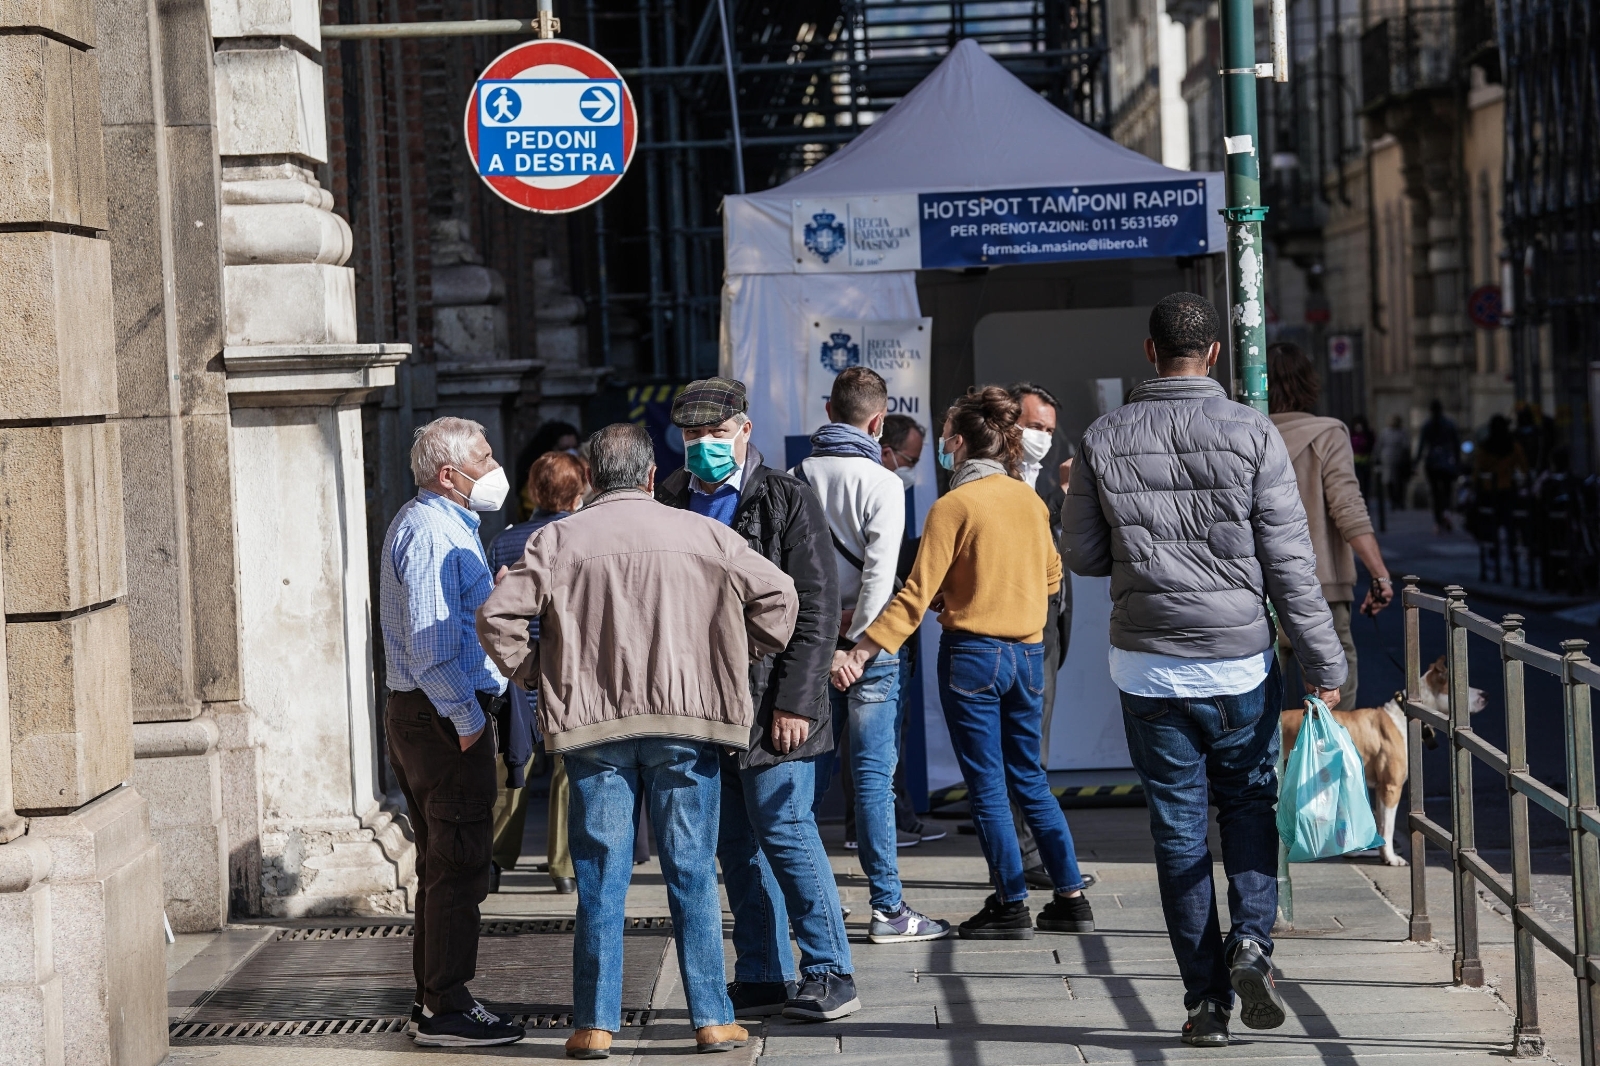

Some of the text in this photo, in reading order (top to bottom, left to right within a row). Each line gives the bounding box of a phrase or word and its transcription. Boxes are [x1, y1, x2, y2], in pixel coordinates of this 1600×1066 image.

[506, 131, 597, 149] PEDONI
[488, 153, 615, 172] A DESTRA
[923, 188, 1204, 219] HOTSPOT TAMPONI RAPIDI
[853, 217, 890, 228] REGIA
[950, 214, 1179, 237] PER PRENOTAZIONI: 011 5631569
[853, 227, 911, 239] FARMACIA
[853, 239, 900, 251] MASINO
[981, 237, 1148, 256] farmacia.masino@libero.it
[867, 339, 902, 349] REGIA
[867, 348, 921, 360] FARMACIA
